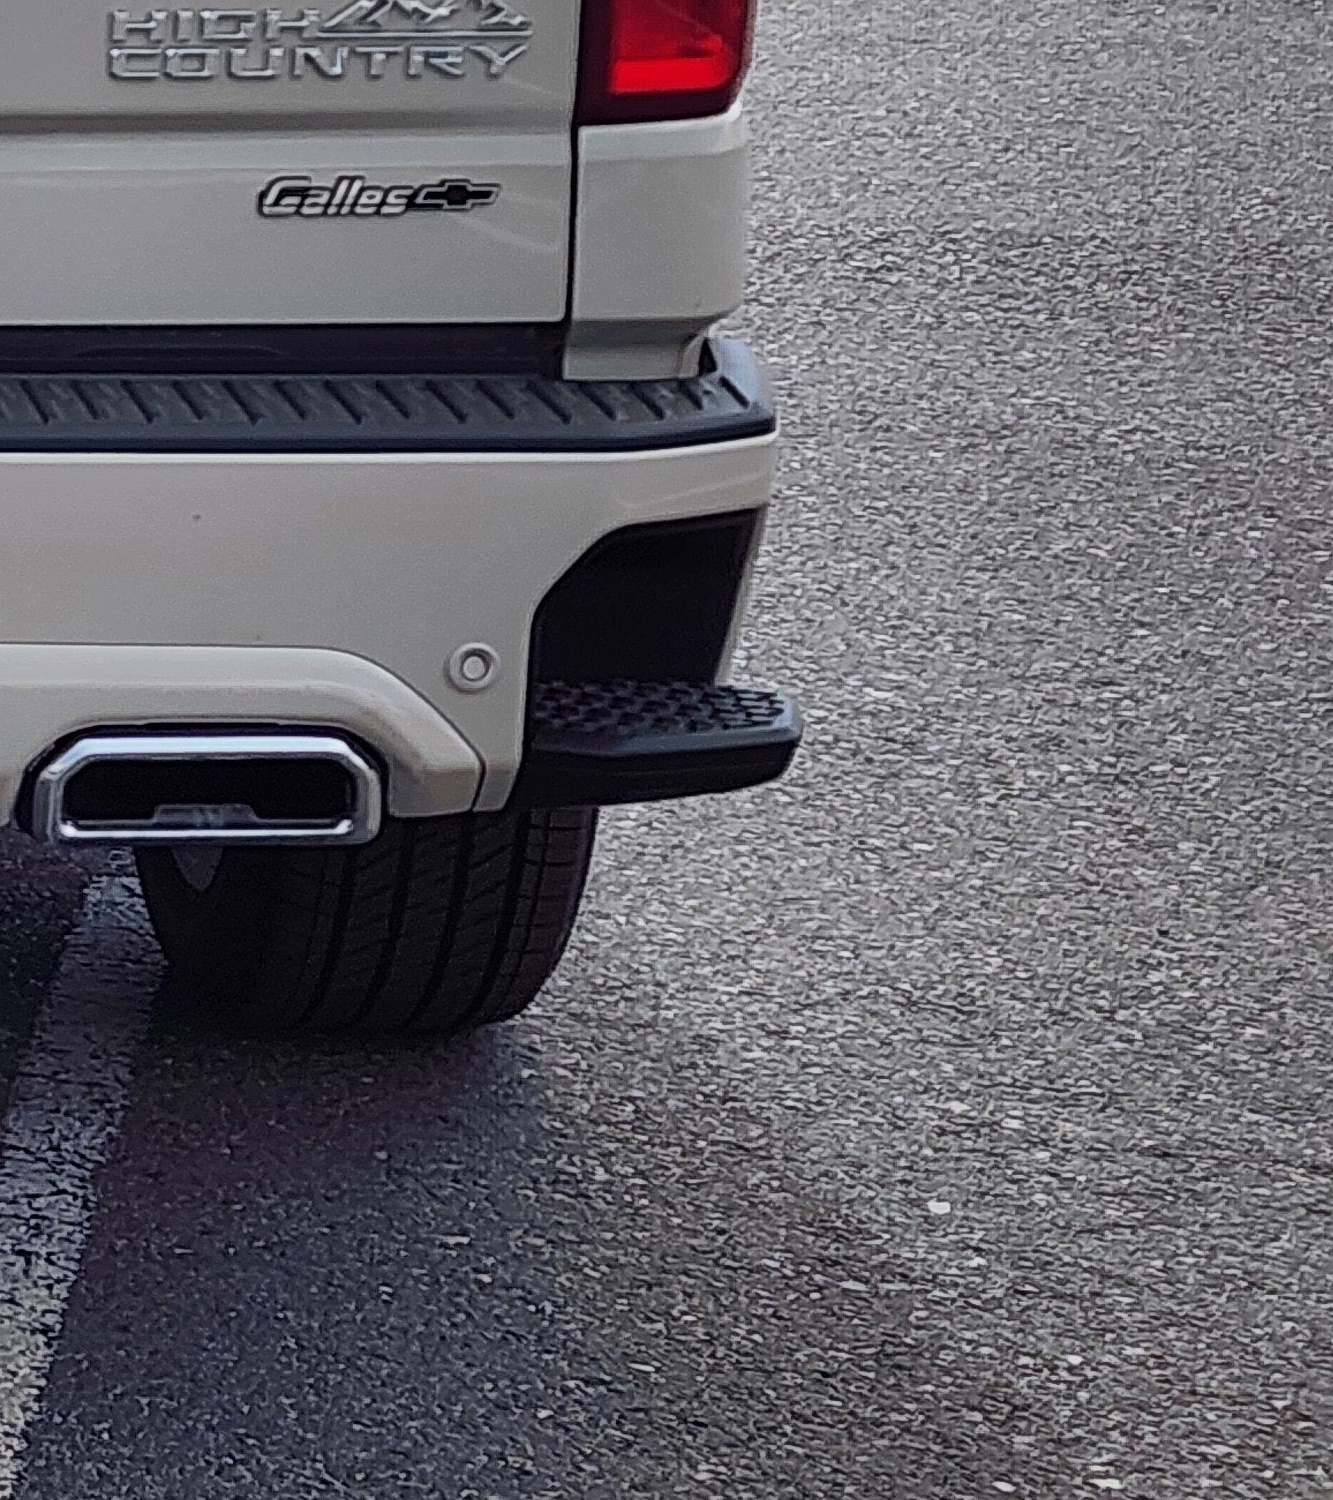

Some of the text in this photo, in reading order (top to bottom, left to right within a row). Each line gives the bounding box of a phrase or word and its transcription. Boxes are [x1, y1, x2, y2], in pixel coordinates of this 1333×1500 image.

[108, 8, 322, 42] HIGH
[108, 45, 530, 80] COUNTRY
[257, 176, 414, 217] Galles
